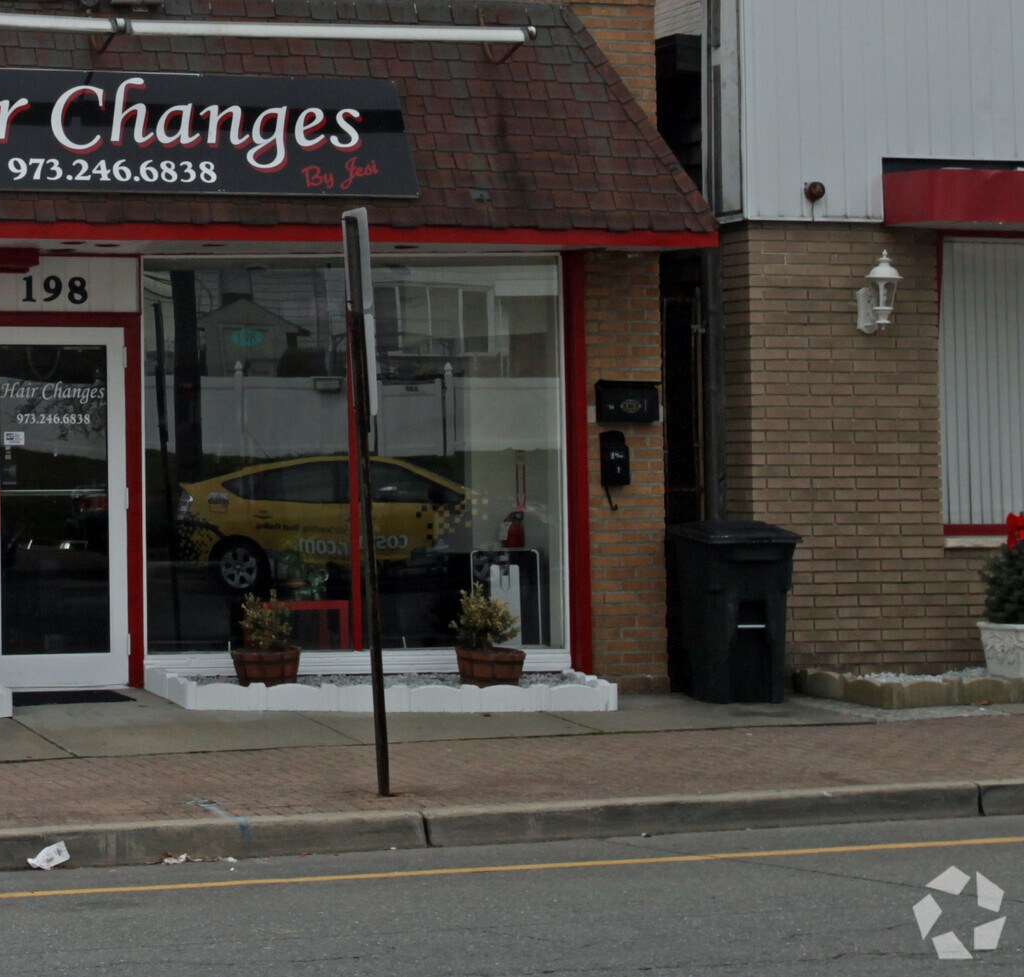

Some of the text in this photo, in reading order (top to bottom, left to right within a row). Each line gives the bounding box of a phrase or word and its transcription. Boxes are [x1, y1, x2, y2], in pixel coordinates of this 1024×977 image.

[51, 77, 363, 173] Changes
[7, 157, 218, 184] 973.246.6838
[301, 165, 334, 189] By
[22, 275, 89, 305] 198
[0, 381, 106, 405] Hair Changes
[16, 413, 91, 425] 973.246.6838
